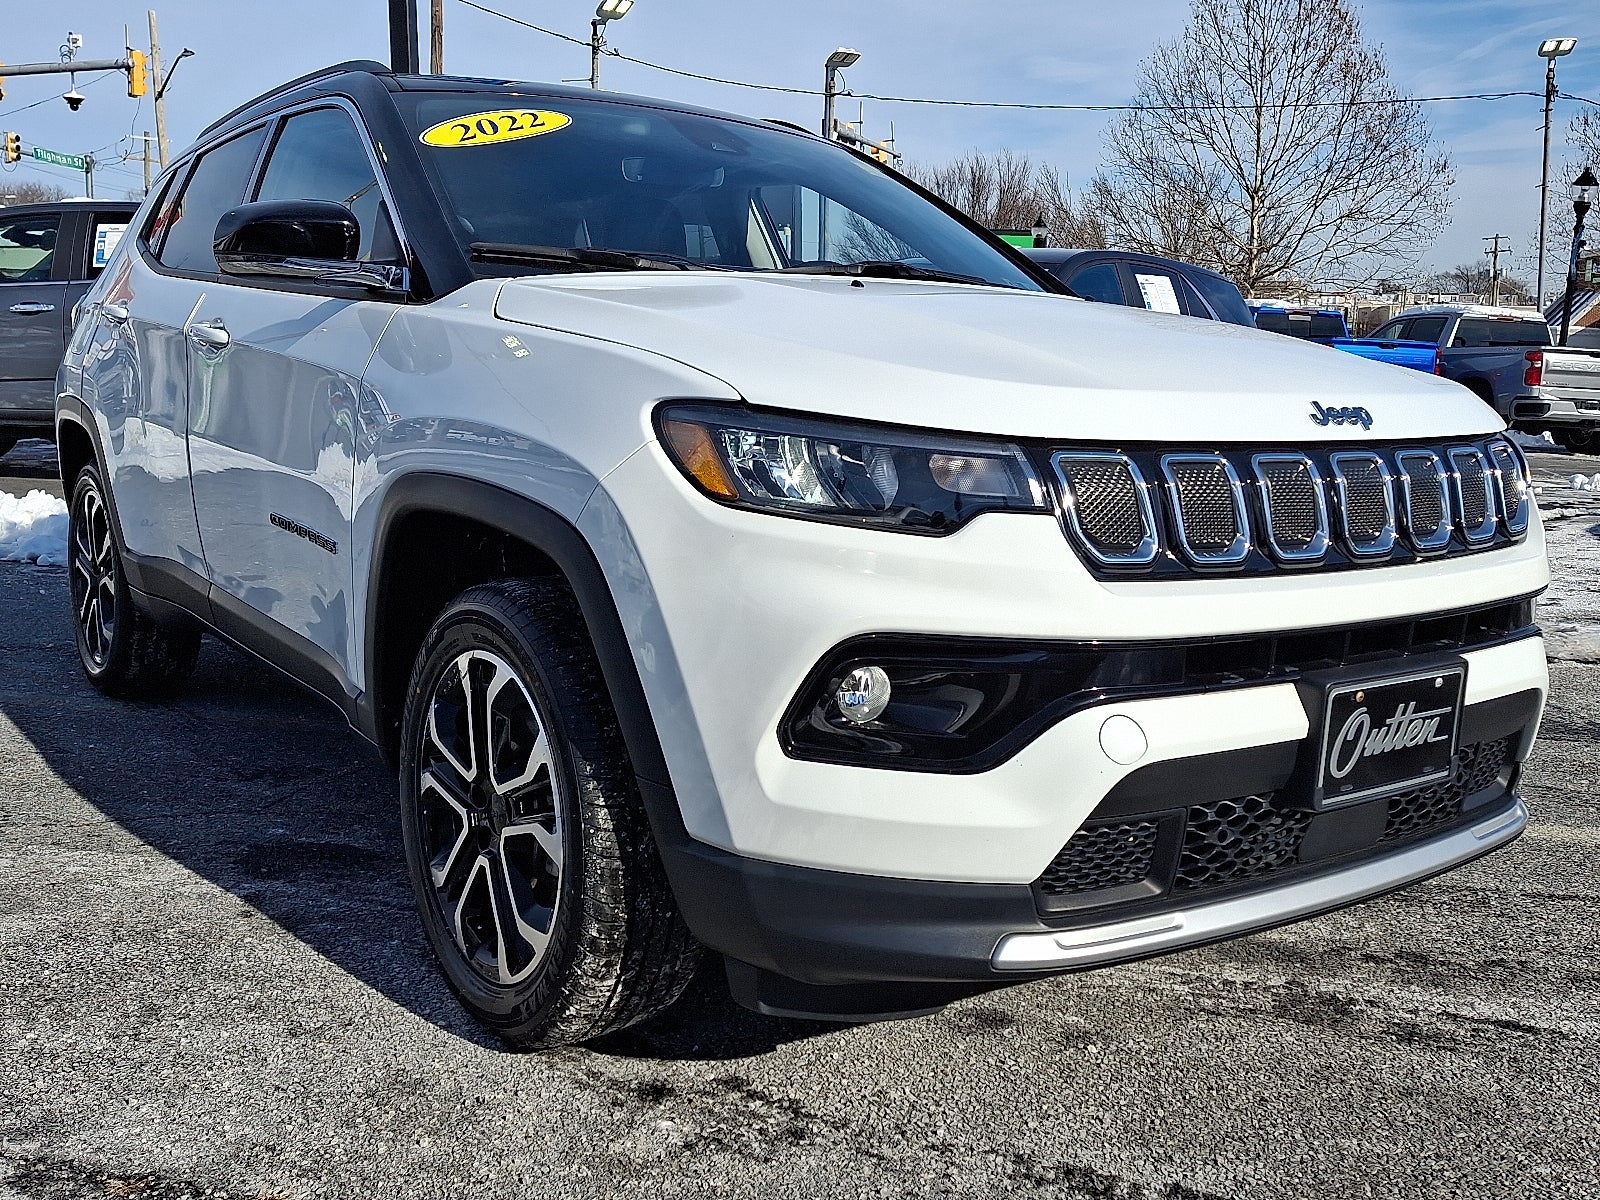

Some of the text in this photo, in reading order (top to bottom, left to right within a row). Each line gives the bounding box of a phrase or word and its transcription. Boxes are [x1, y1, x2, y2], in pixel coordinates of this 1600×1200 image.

[450, 112, 546, 142] 2022
[35, 148, 83, 167] Tilghman St
[1309, 400, 1374, 431] Jeep
[268, 511, 338, 555] COMPASS
[1329, 701, 1453, 779] Outten
